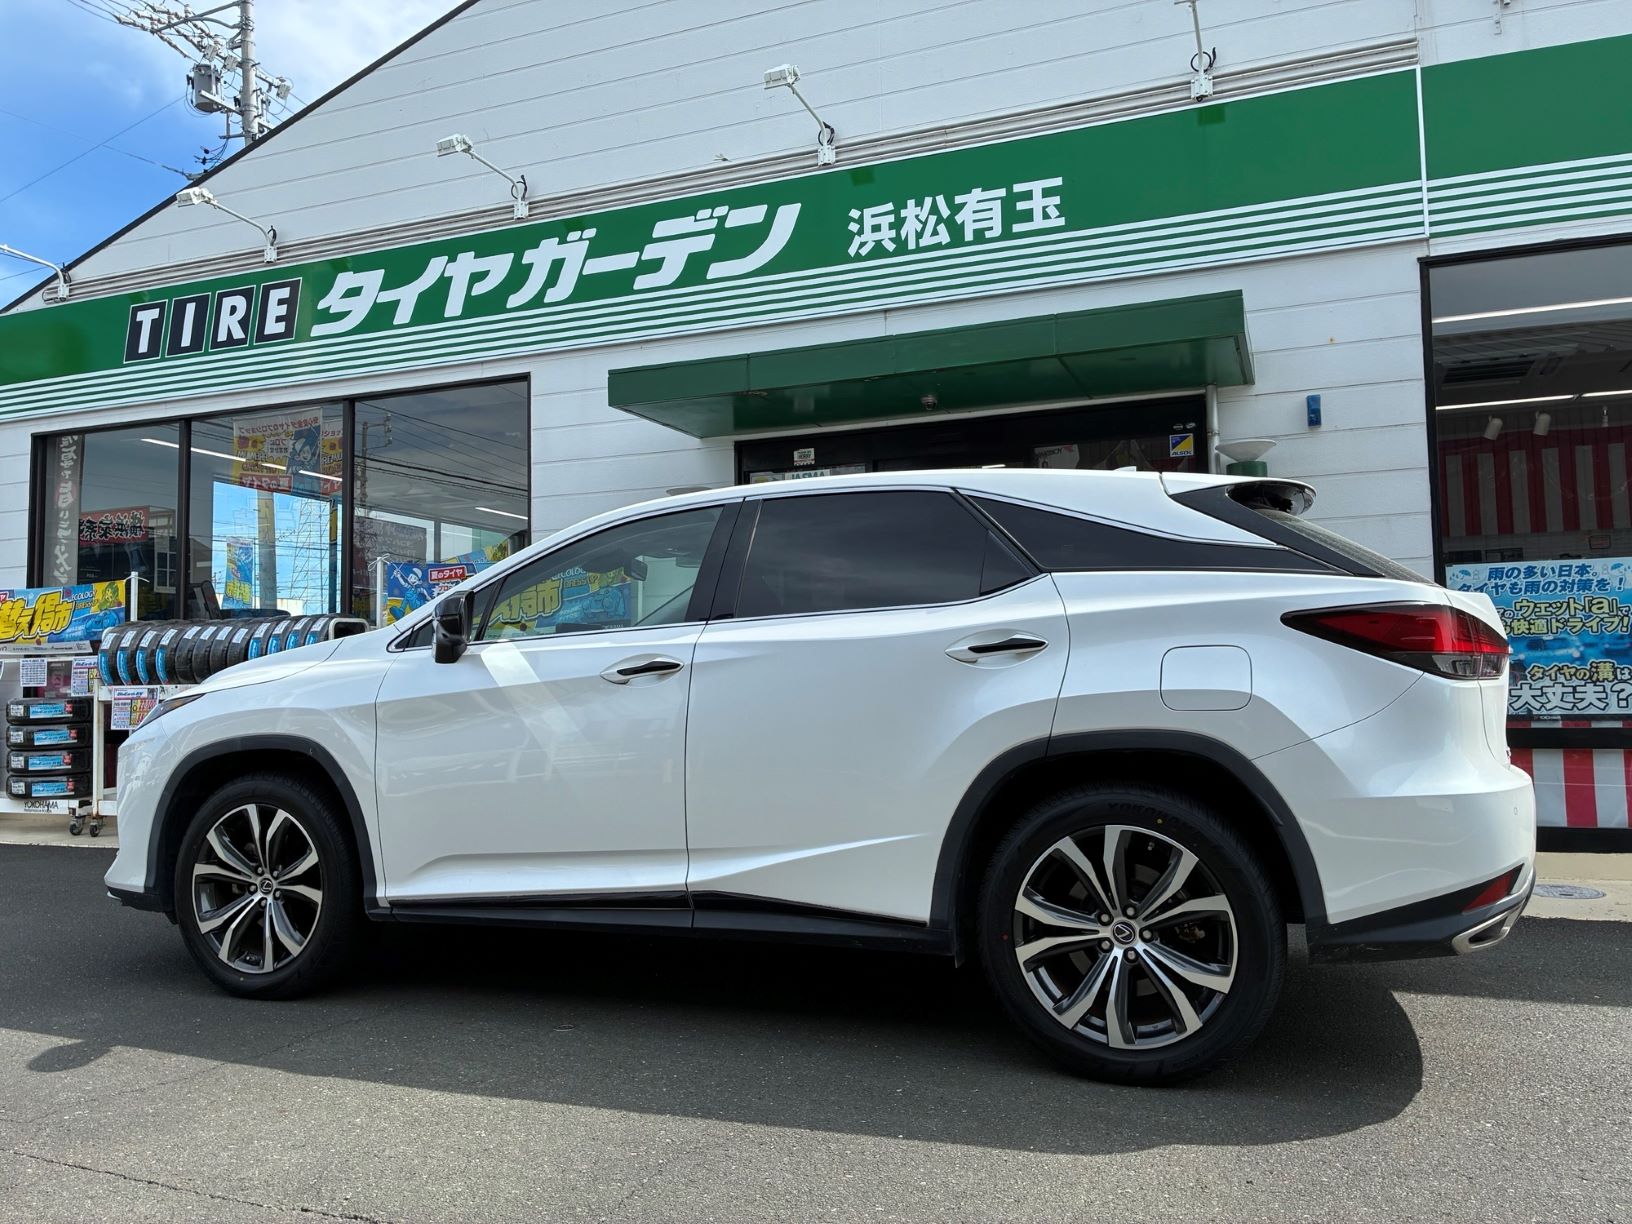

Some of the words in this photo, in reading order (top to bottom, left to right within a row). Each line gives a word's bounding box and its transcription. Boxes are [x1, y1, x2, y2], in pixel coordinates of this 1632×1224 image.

[847, 177, 1067, 257] 浜松有玉
[310, 203, 802, 337] タイヤガーデン
[130, 284, 294, 358] TIRE
[430, 568, 463, 580] 夏のタイヤ
[1487, 564, 1598, 582] 雨の多い日本。
[1529, 661, 1632, 681] タイヤの溝は
[1509, 683, 1632, 711] 大丈夫？
